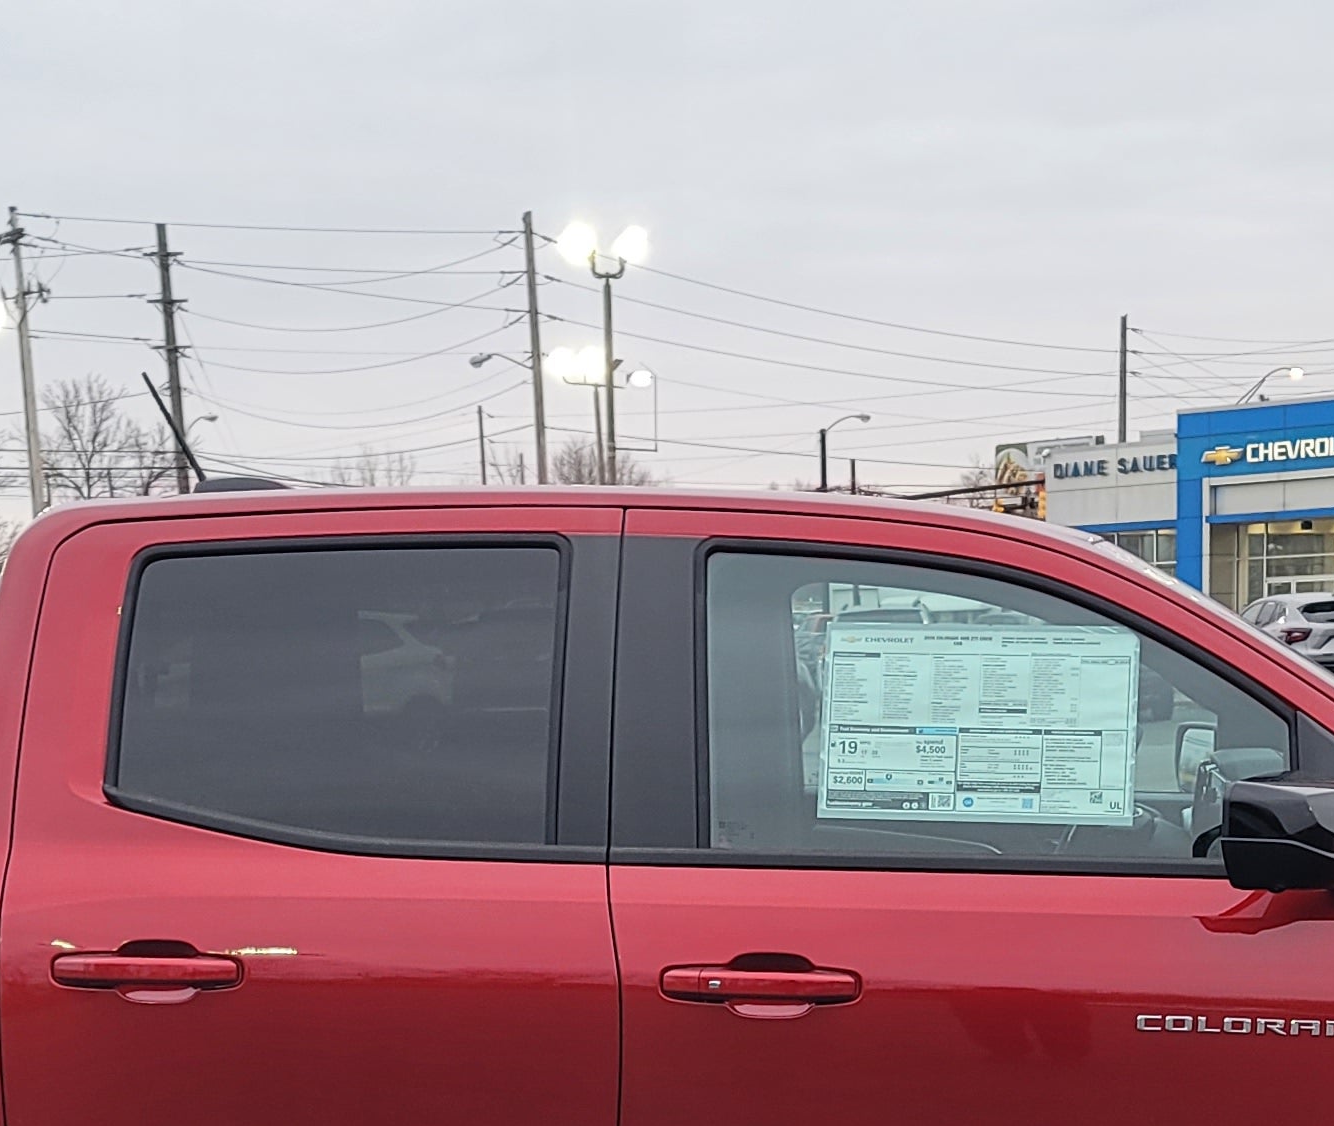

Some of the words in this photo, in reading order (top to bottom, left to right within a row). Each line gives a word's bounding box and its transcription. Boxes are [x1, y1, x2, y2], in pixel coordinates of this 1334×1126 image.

[1053, 459, 1110, 480] DIANE
[864, 636, 915, 644] CHEVROLET
[838, 740, 858, 755] 19
[916, 745, 946, 755] $4,500
[1109, 801, 1122, 810] UL
